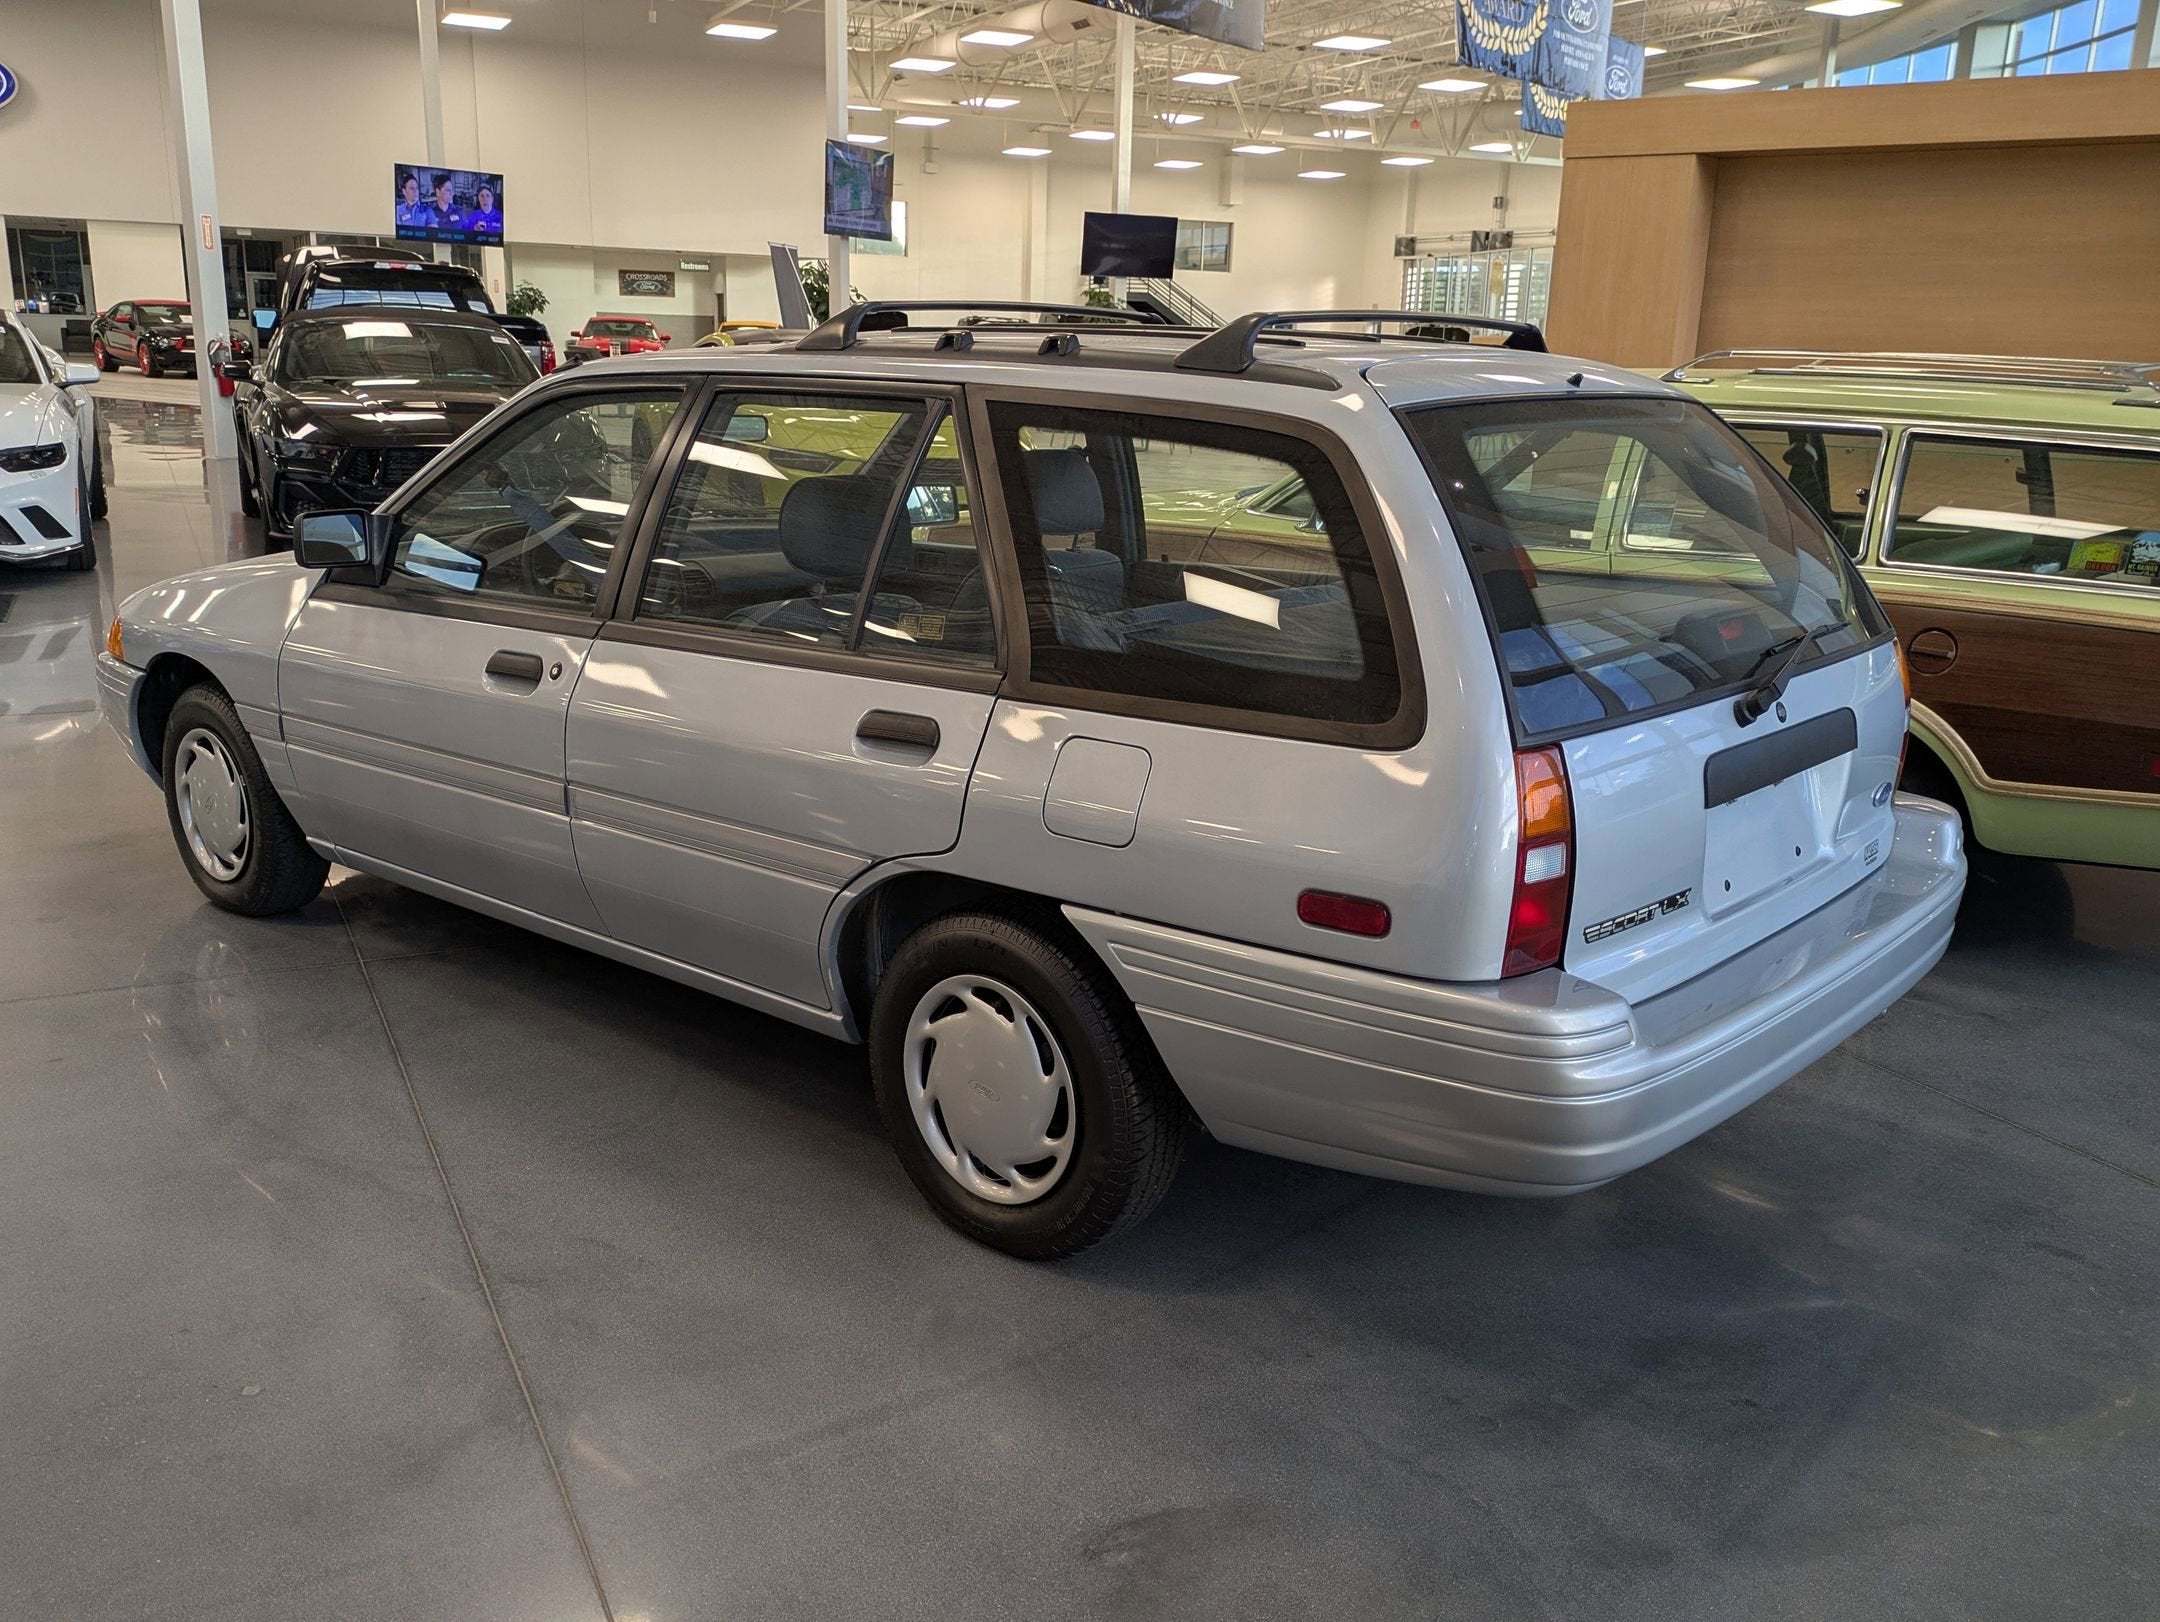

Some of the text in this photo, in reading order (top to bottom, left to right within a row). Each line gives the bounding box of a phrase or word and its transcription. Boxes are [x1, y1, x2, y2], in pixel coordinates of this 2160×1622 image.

[1567, 0, 1593, 26] Ford
[1608, 69, 1629, 94] Ford
[625, 273, 668, 281] CROSSROADS
[680, 262, 709, 271] Restrooms
[1583, 889, 1691, 943] ESCORT LX
